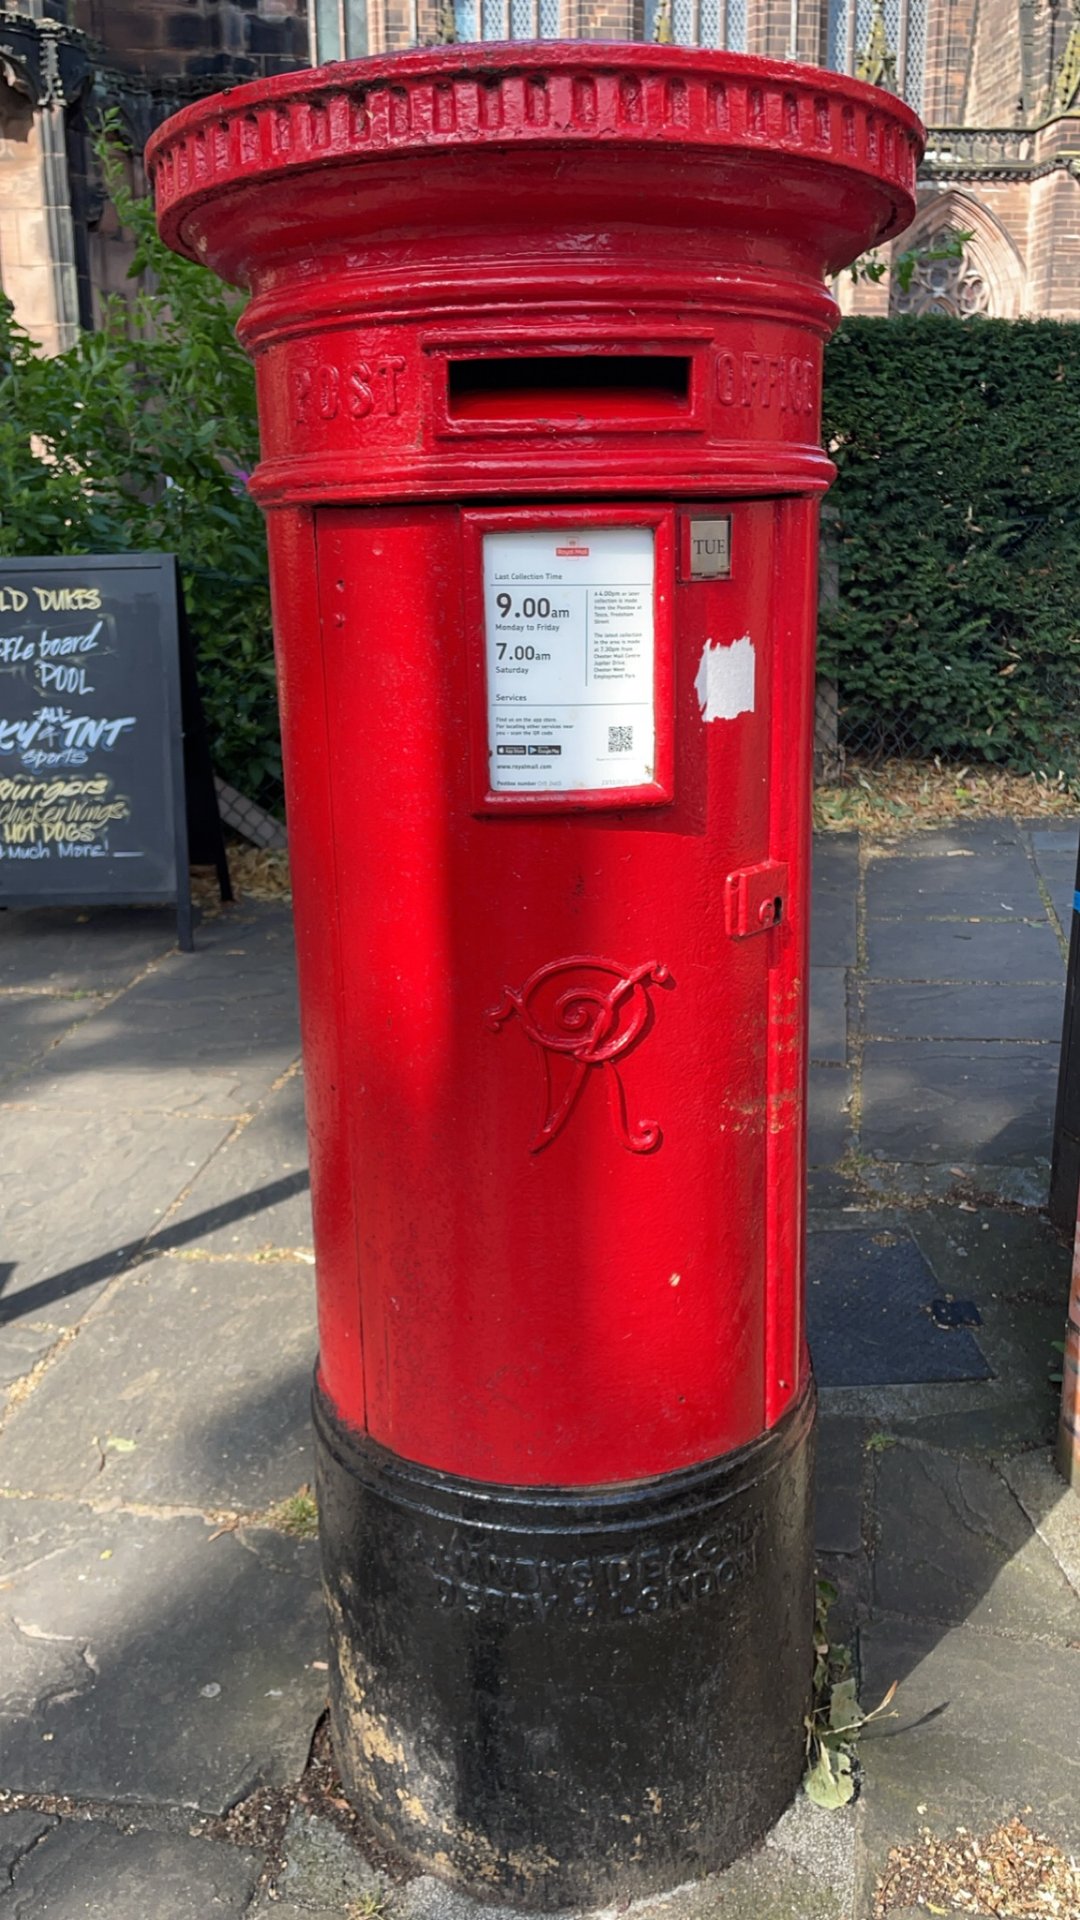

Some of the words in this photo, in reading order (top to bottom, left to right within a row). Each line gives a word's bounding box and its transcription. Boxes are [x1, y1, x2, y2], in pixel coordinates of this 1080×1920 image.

[292, 354, 406, 423] POST
[715, 349, 814, 415] OFFICE
[693, 539, 725, 555] TUE
[32, 587, 101, 611] DUKES
[496, 592, 570, 618] 9.00am
[39, 621, 102, 658] board
[495, 623, 525, 633] Monday
[536, 623, 560, 632] Friday
[495, 642, 551, 661] 7.00am
[38, 661, 94, 694] POOL
[495, 666, 529, 675] Saturday
[495, 693, 527, 702] Services
[61, 716, 136, 748] TNT
[496, 763, 552, 771] www.royalmail.com
[4, 822, 38, 844] HOT
[41, 821, 95, 842] DOGS
[610, 1548, 757, 1615] LONDON
